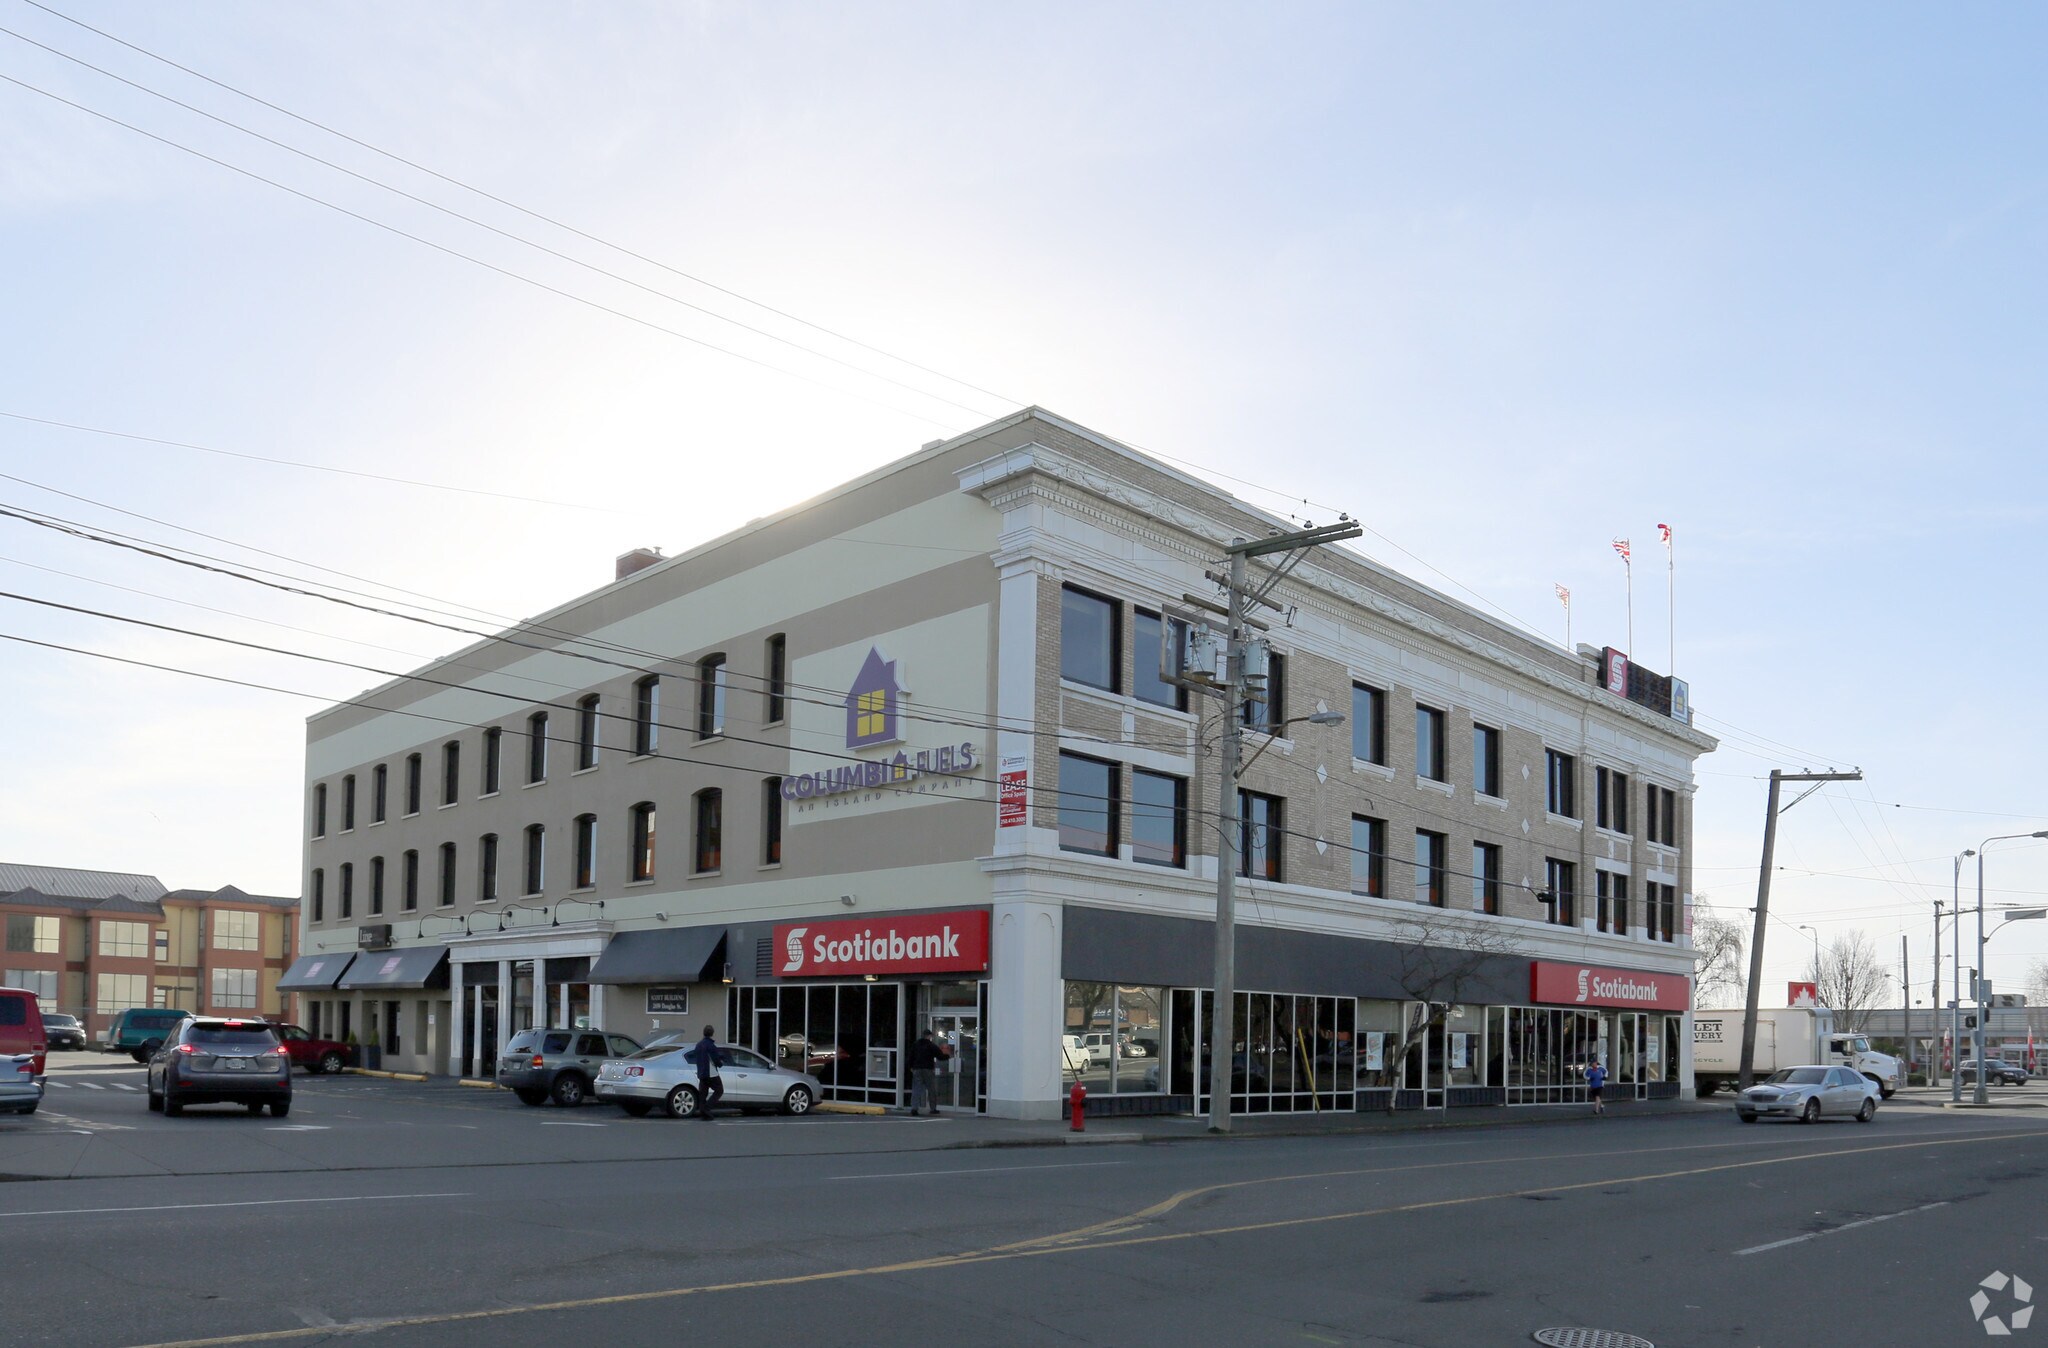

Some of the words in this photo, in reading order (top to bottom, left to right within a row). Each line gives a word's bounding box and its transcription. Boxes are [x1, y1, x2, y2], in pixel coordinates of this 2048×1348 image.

[916, 742, 975, 777] FUELS
[1001, 780, 1026, 792] LEASE
[825, 793, 882, 809] ISLAND
[813, 925, 960, 963] Scotiabank
[1592, 976, 1658, 1001] Scotiabank
